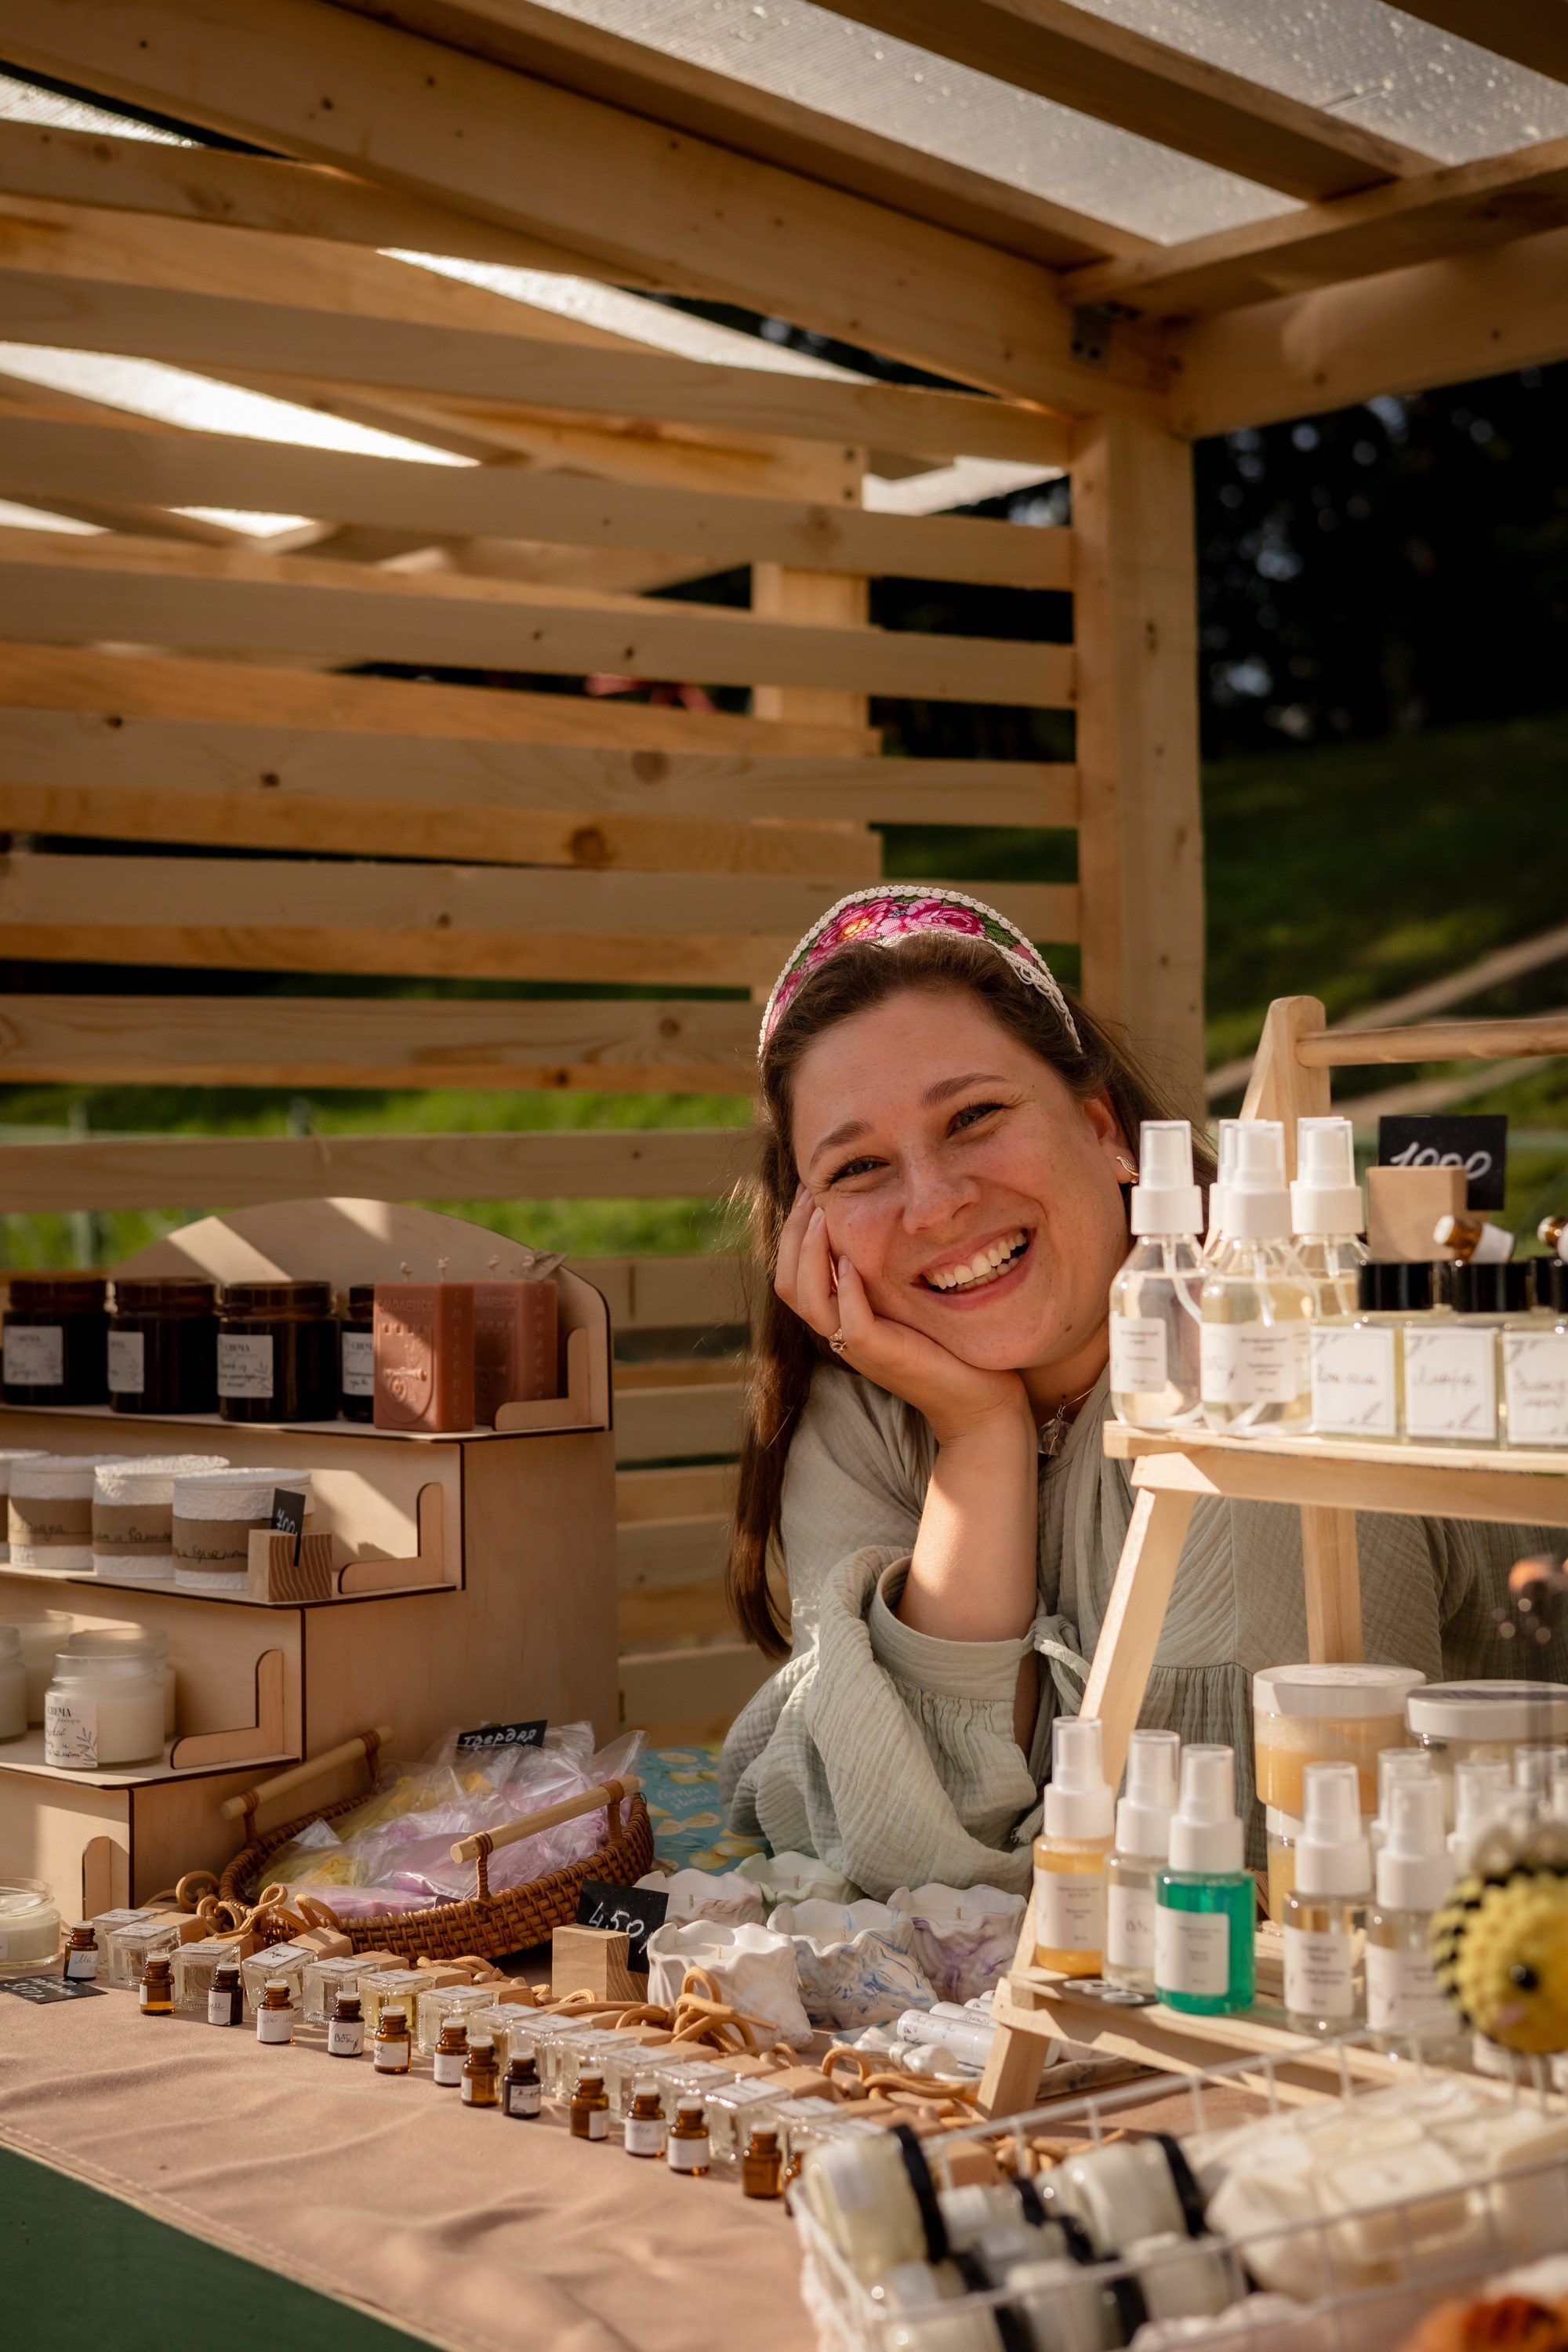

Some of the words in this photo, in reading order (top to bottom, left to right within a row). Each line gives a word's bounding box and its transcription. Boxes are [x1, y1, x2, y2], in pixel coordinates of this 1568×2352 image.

[350, 1341, 373, 1351] СВЕЧ
[535, 1288, 545, 1399] СМОЛЕНС
[47, 1705, 71, 1718] СВЕЧА
